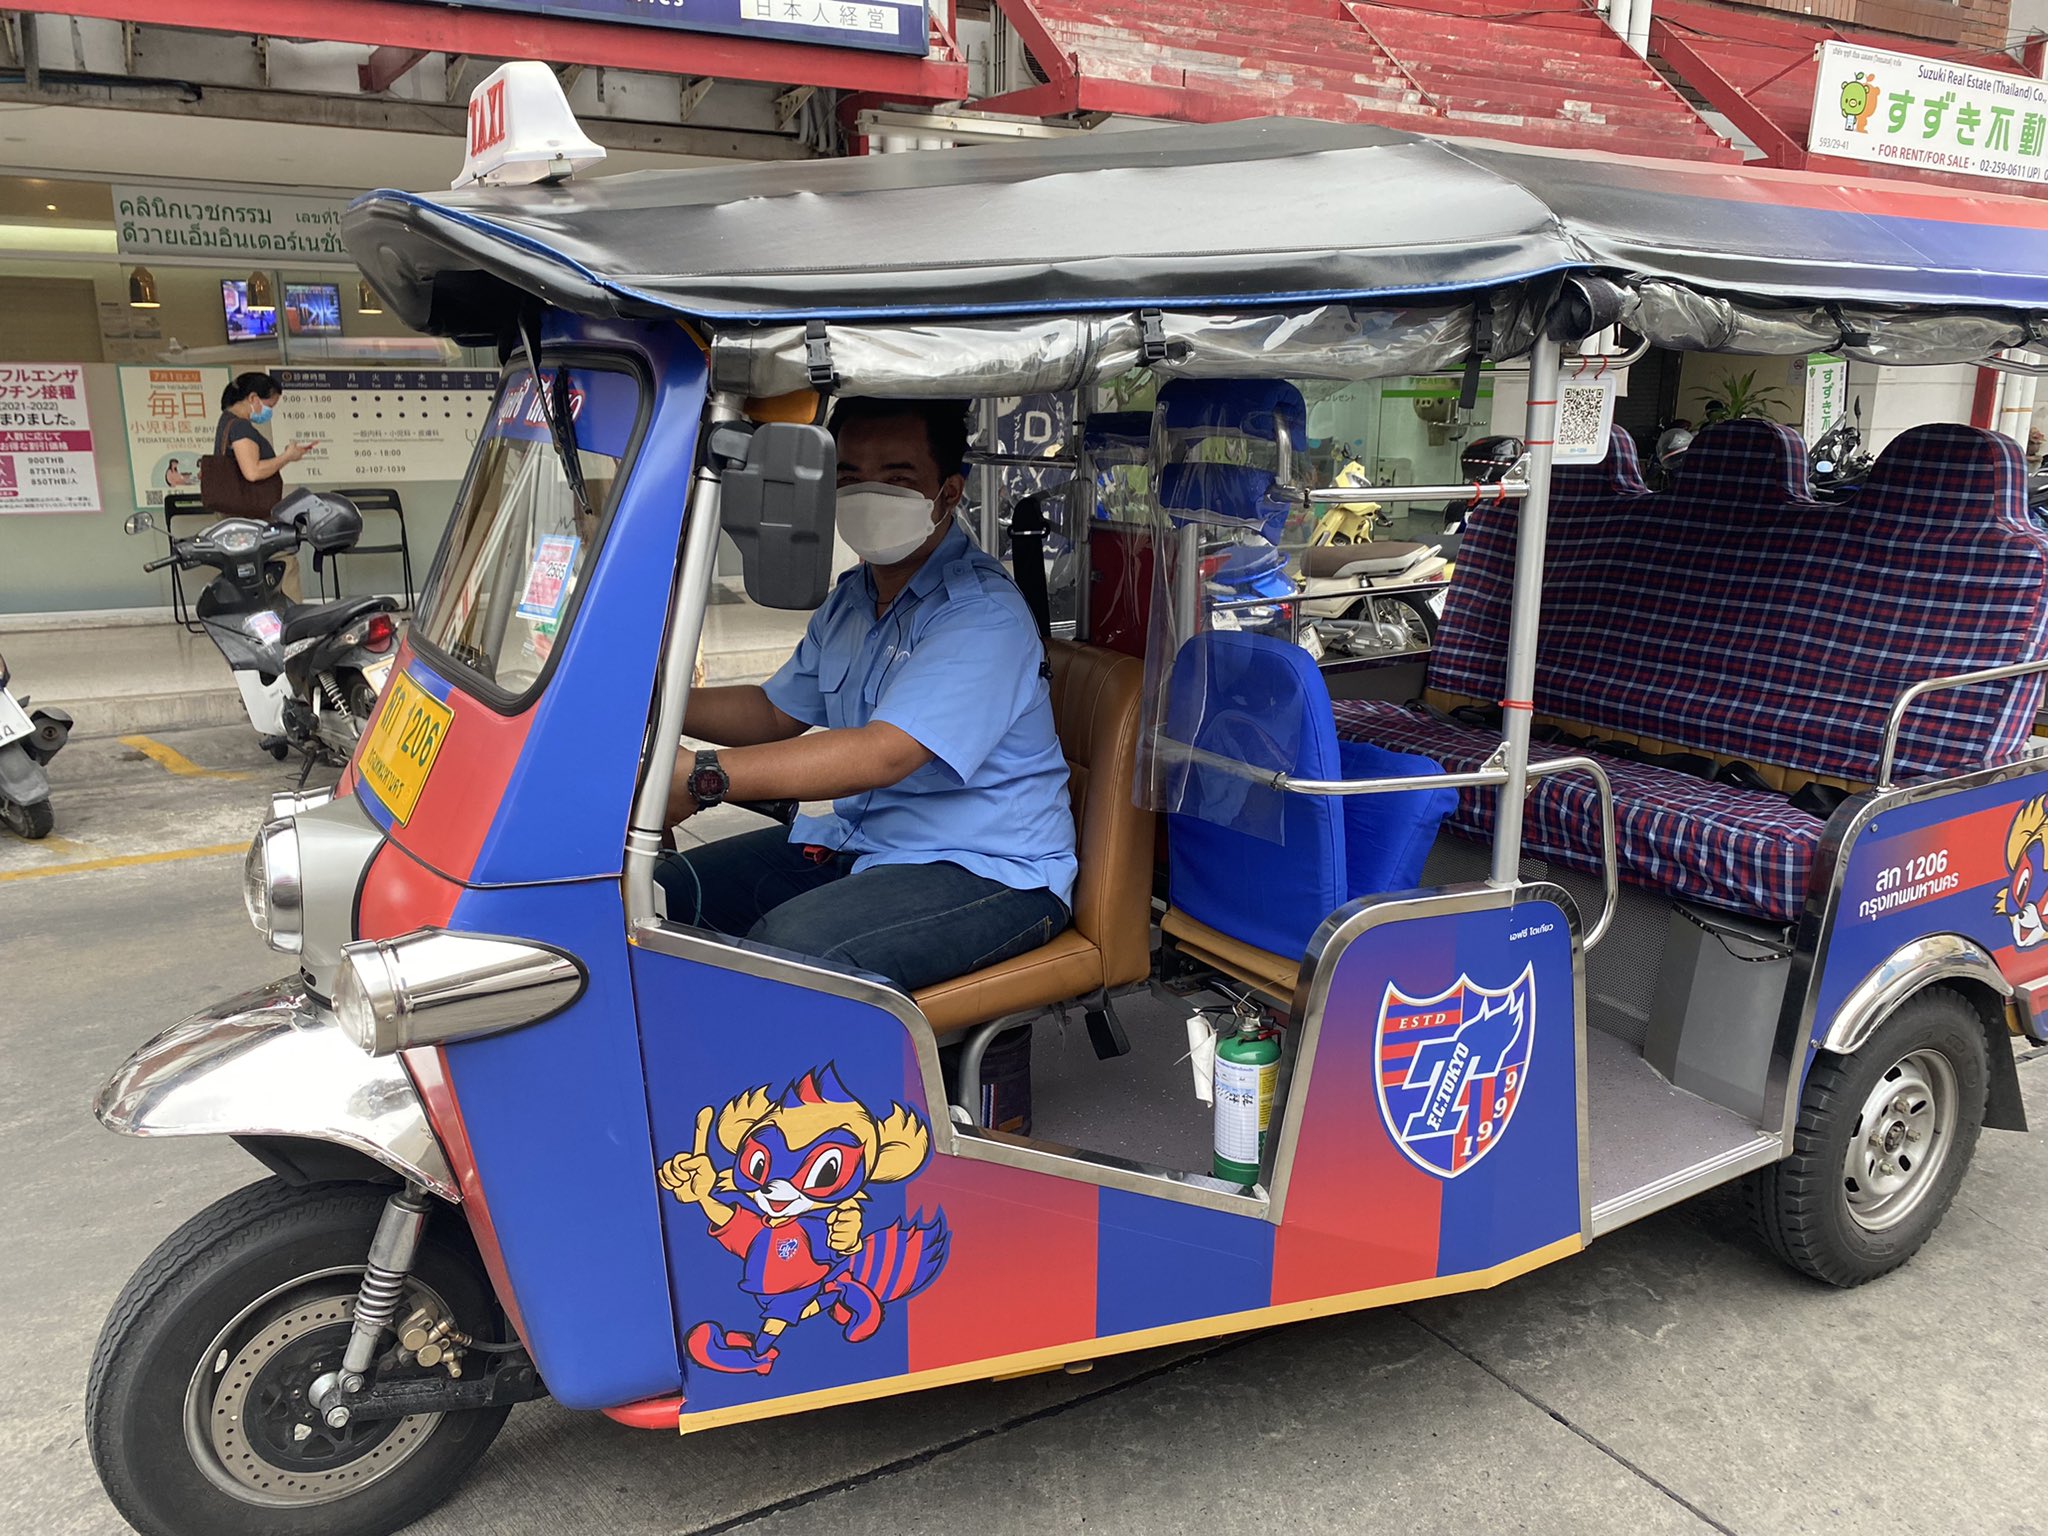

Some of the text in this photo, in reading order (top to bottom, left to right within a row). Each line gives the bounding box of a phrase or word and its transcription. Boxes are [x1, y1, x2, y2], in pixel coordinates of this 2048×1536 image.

[756, 0, 884, 29] 日本人経営
[1918, 64, 1947, 82] Suzuki
[1948, 71, 1966, 87] Real
[1967, 75, 1992, 92] Estate
[1993, 80, 2032, 101] (Thailand)
[470, 79, 505, 157] TAXI
[1878, 144, 1898, 158] FOR
[1899, 147, 1946, 165] RENT/FOR
[1947, 153, 1969, 169] SALE
[1980, 159, 2026, 177] 02-259-0611
[119, 195, 272, 224] คลินิกเวชกรรม
[147, 389, 206, 419] 毎日
[306, 467, 323, 477] TEL
[397, 702, 440, 767] 1206
[1875, 850, 1949, 893] สก 1206
[1399, 1012, 1447, 1030] ESTD
[1459, 1070, 1518, 1158] 1999
